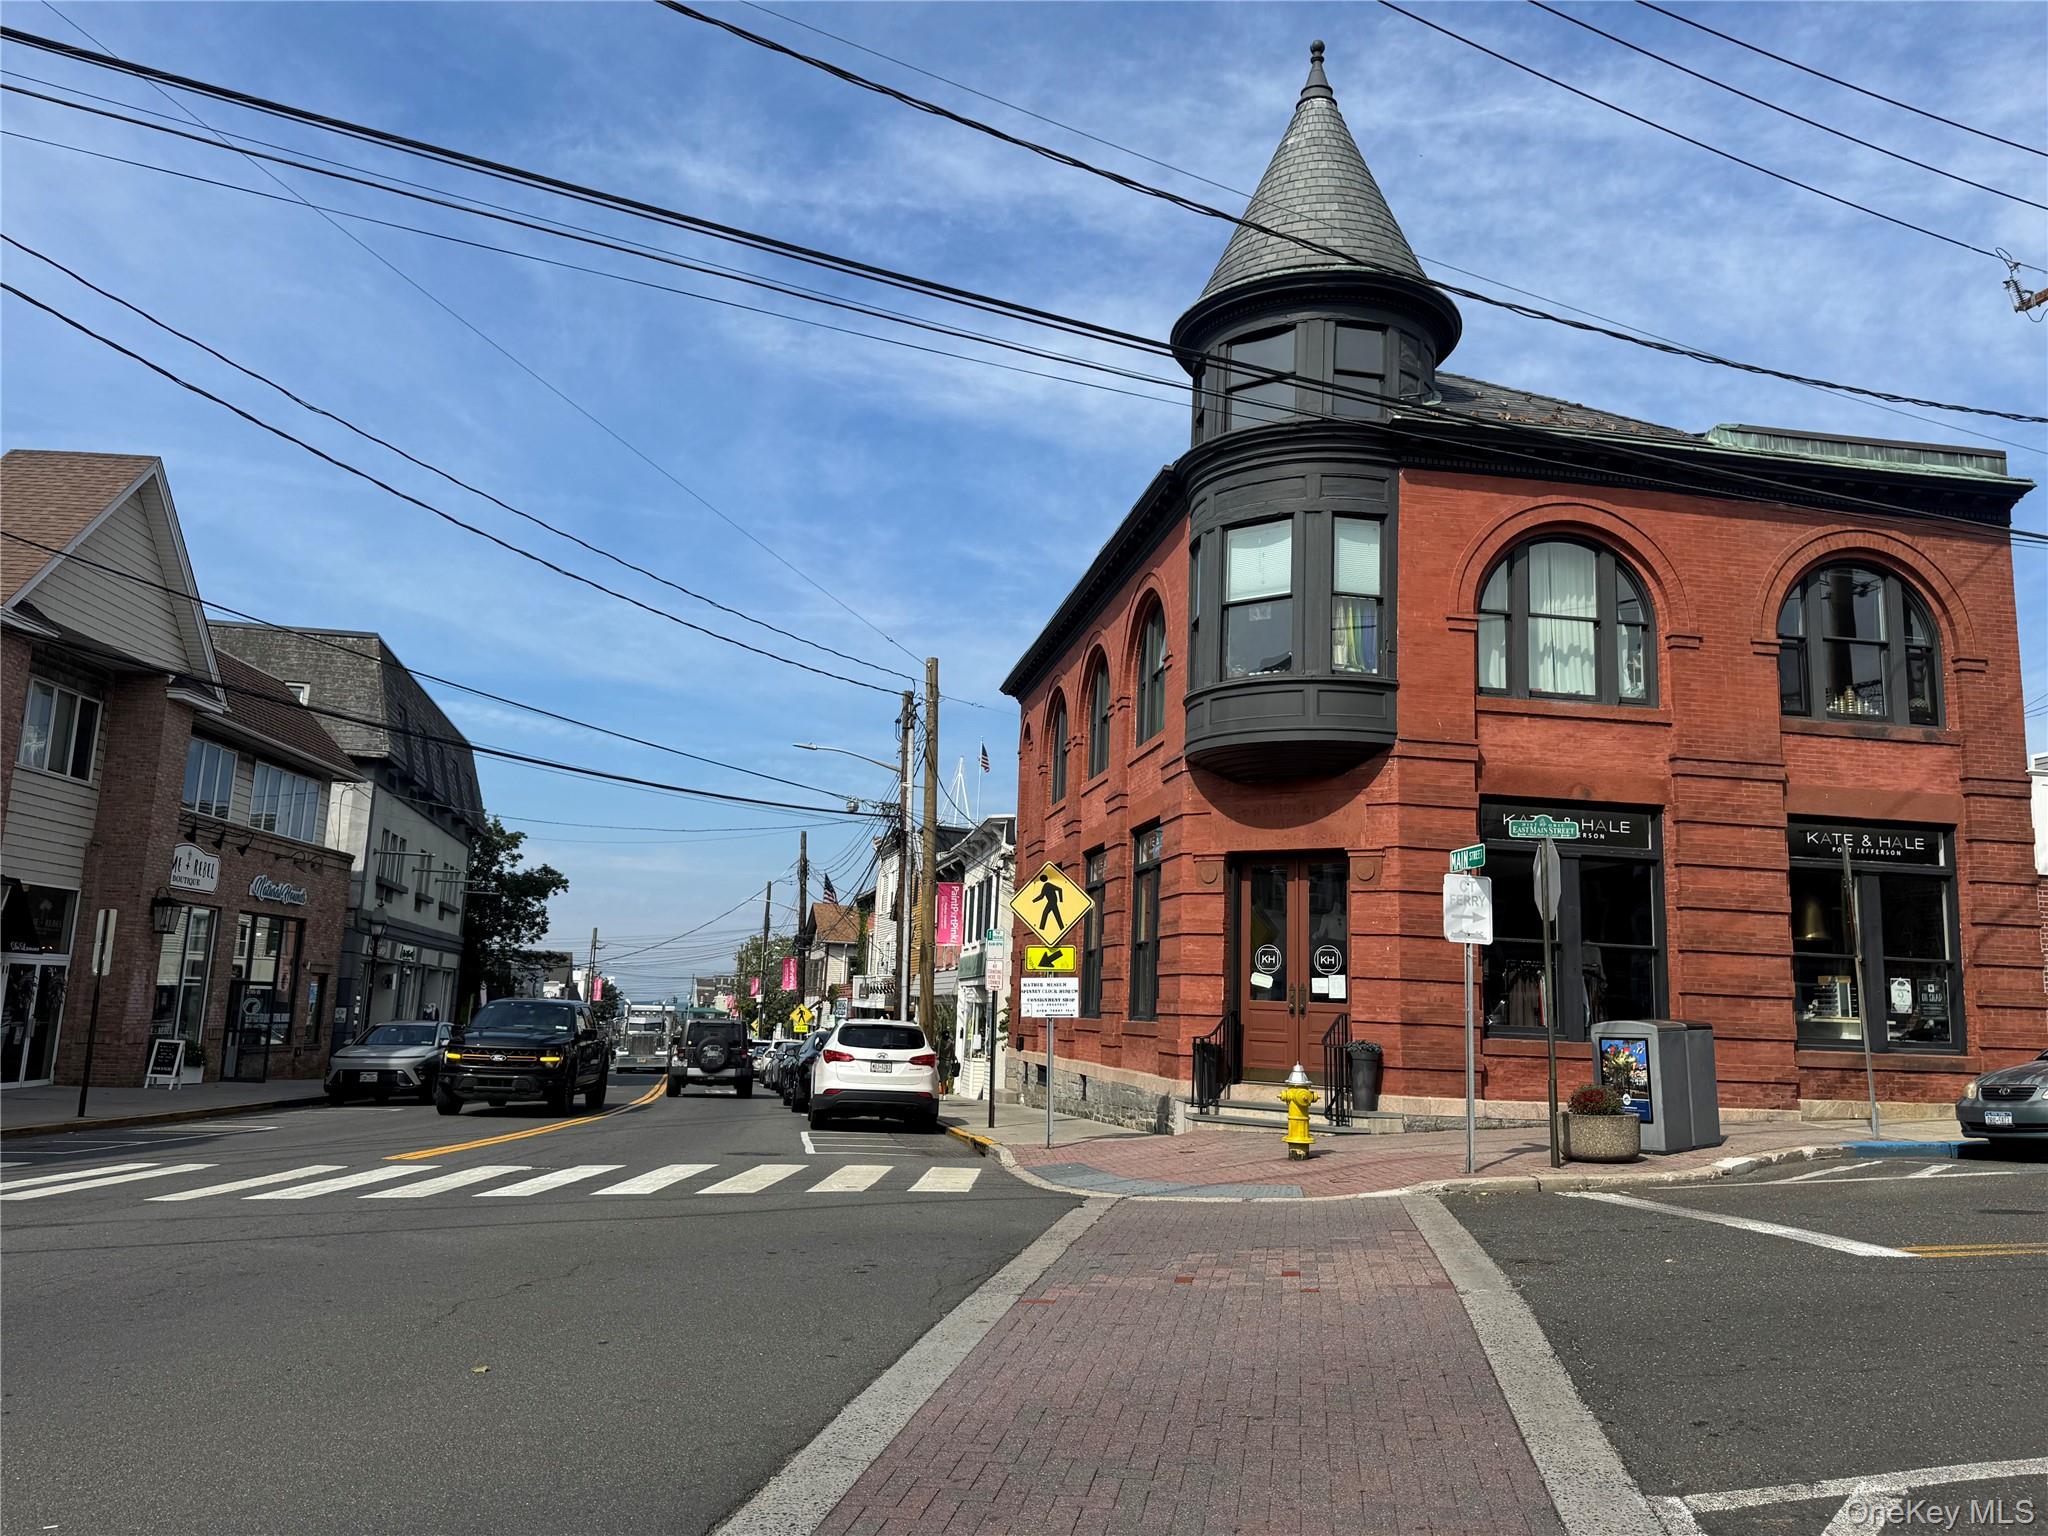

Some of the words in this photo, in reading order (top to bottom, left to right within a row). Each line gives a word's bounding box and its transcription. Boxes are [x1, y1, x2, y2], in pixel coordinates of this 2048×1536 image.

[1512, 825, 1530, 834] EAST
[1530, 825, 1549, 835] MAIN
[1549, 826, 1575, 835] STREET
[1581, 818, 1631, 836] HALE
[1806, 831, 1854, 846] KATE
[1861, 834, 1872, 847] &
[1879, 836, 1925, 850] HALE
[1832, 846, 1852, 854] POT
[1856, 848, 1902, 856] JEFFERSON
[1451, 850, 1469, 872] MAIN
[193, 858, 215, 880] REBEL
[171, 874, 201, 886] BOUTIQUE
[1460, 879, 1476, 893] CT
[1450, 894, 1486, 907] FERRY
[1261, 955, 1275, 964] KH
[1320, 955, 1335, 964] KH
